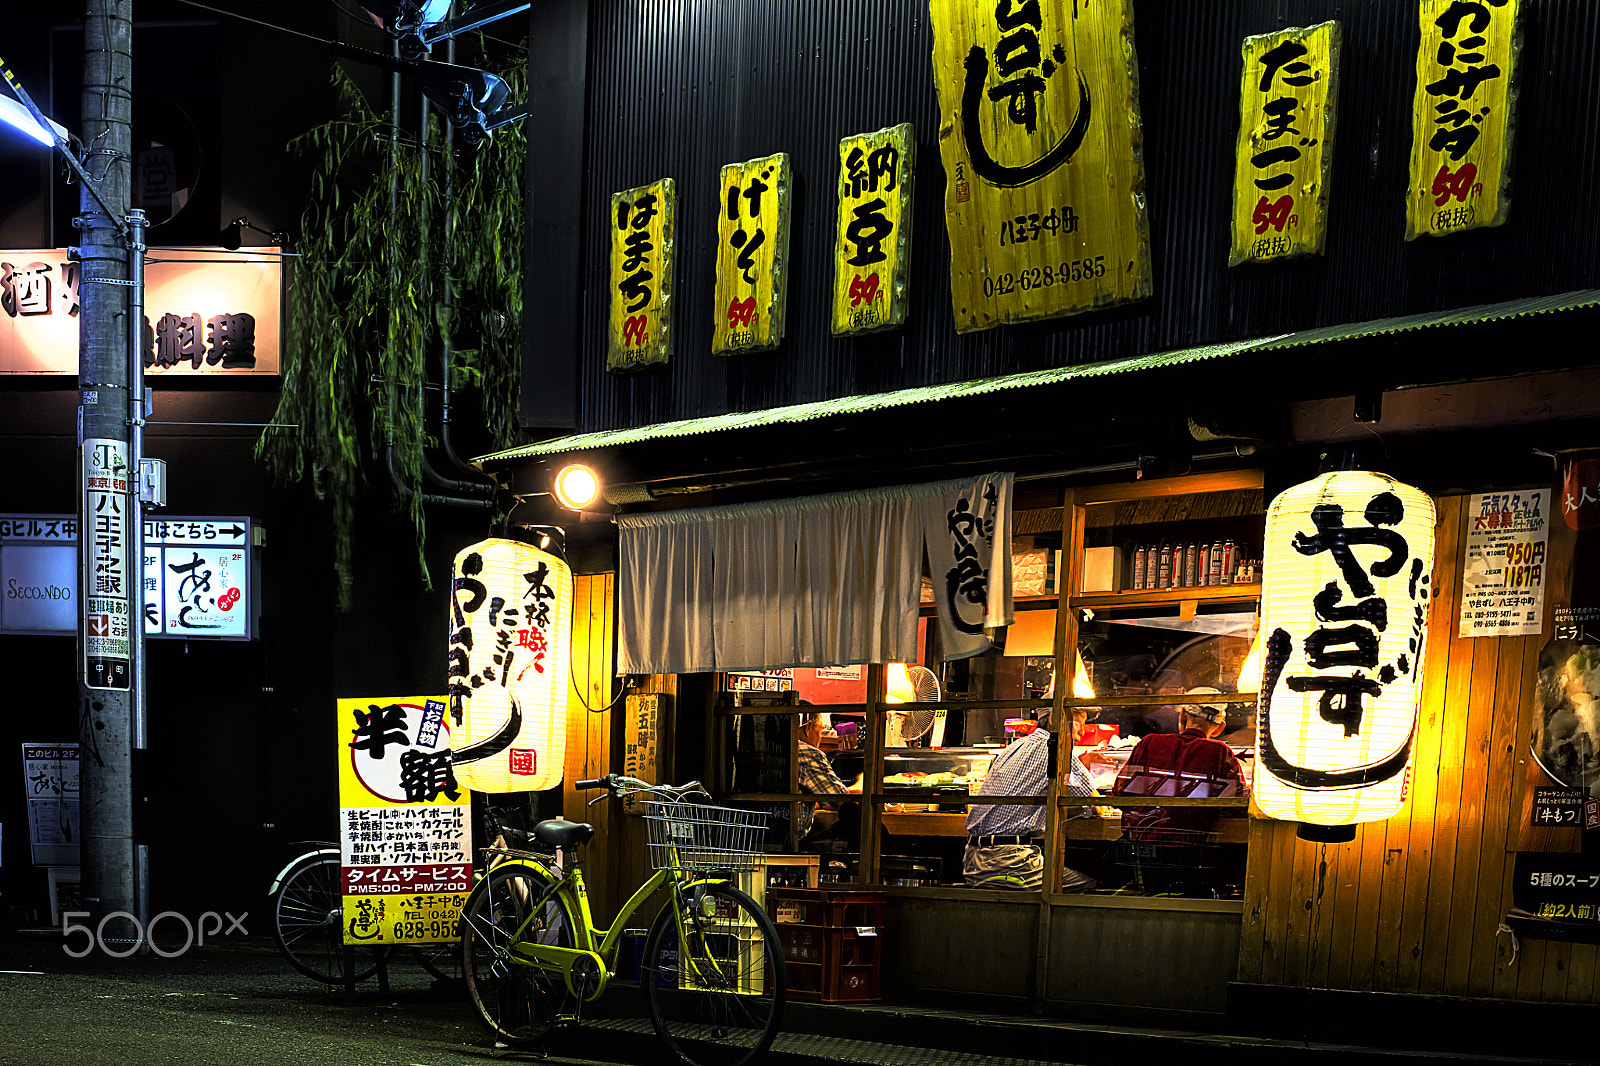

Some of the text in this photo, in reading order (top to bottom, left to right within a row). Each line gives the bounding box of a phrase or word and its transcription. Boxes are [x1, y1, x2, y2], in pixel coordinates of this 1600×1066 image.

[1251, 39, 1318, 191] たまご
[844, 142, 899, 267] 納豆
[728, 165, 775, 285] げそ
[1000, 206, 1080, 247] 八王子中町
[1430, 205, 1474, 230] (税抜)
[617, 193, 659, 314] はまち
[1252, 235, 1292, 258] (税抜)
[983, 255, 1106, 299] 042-628-9585
[849, 309, 880, 328] (税抜)
[144, 312, 256, 369] 料理
[727, 330, 755, 349] (税抜)
[1481, 492, 1542, 516] 元気スタッフ
[1564, 482, 1600, 515] 大人
[1474, 511, 1513, 530] 大募集
[1513, 509, 1540, 519] 正社員
[95, 495, 122, 595] 八王子之家
[1506, 541, 1546, 565] 950円
[1503, 564, 1542, 588] 1187円
[7, 578, 71, 601] SECONDO
[88, 599, 129, 615] 駐車場あり
[1468, 596, 1536, 609] や台ずし 八王子中町
[111, 627, 128, 637] 右折
[112, 616, 128, 627] ここ
[515, 561, 556, 682] 本格職人
[488, 597, 520, 688] にぎり
[418, 709, 442, 747] お飲物
[28, 749, 76, 759] このビル 2F
[348, 704, 462, 803] 半額
[1587, 802, 1598, 826] 国産
[347, 866, 468, 883] タイムサービス
[399, 895, 466, 909] 八王子中町
[405, 909, 459, 920] TEL (042)
